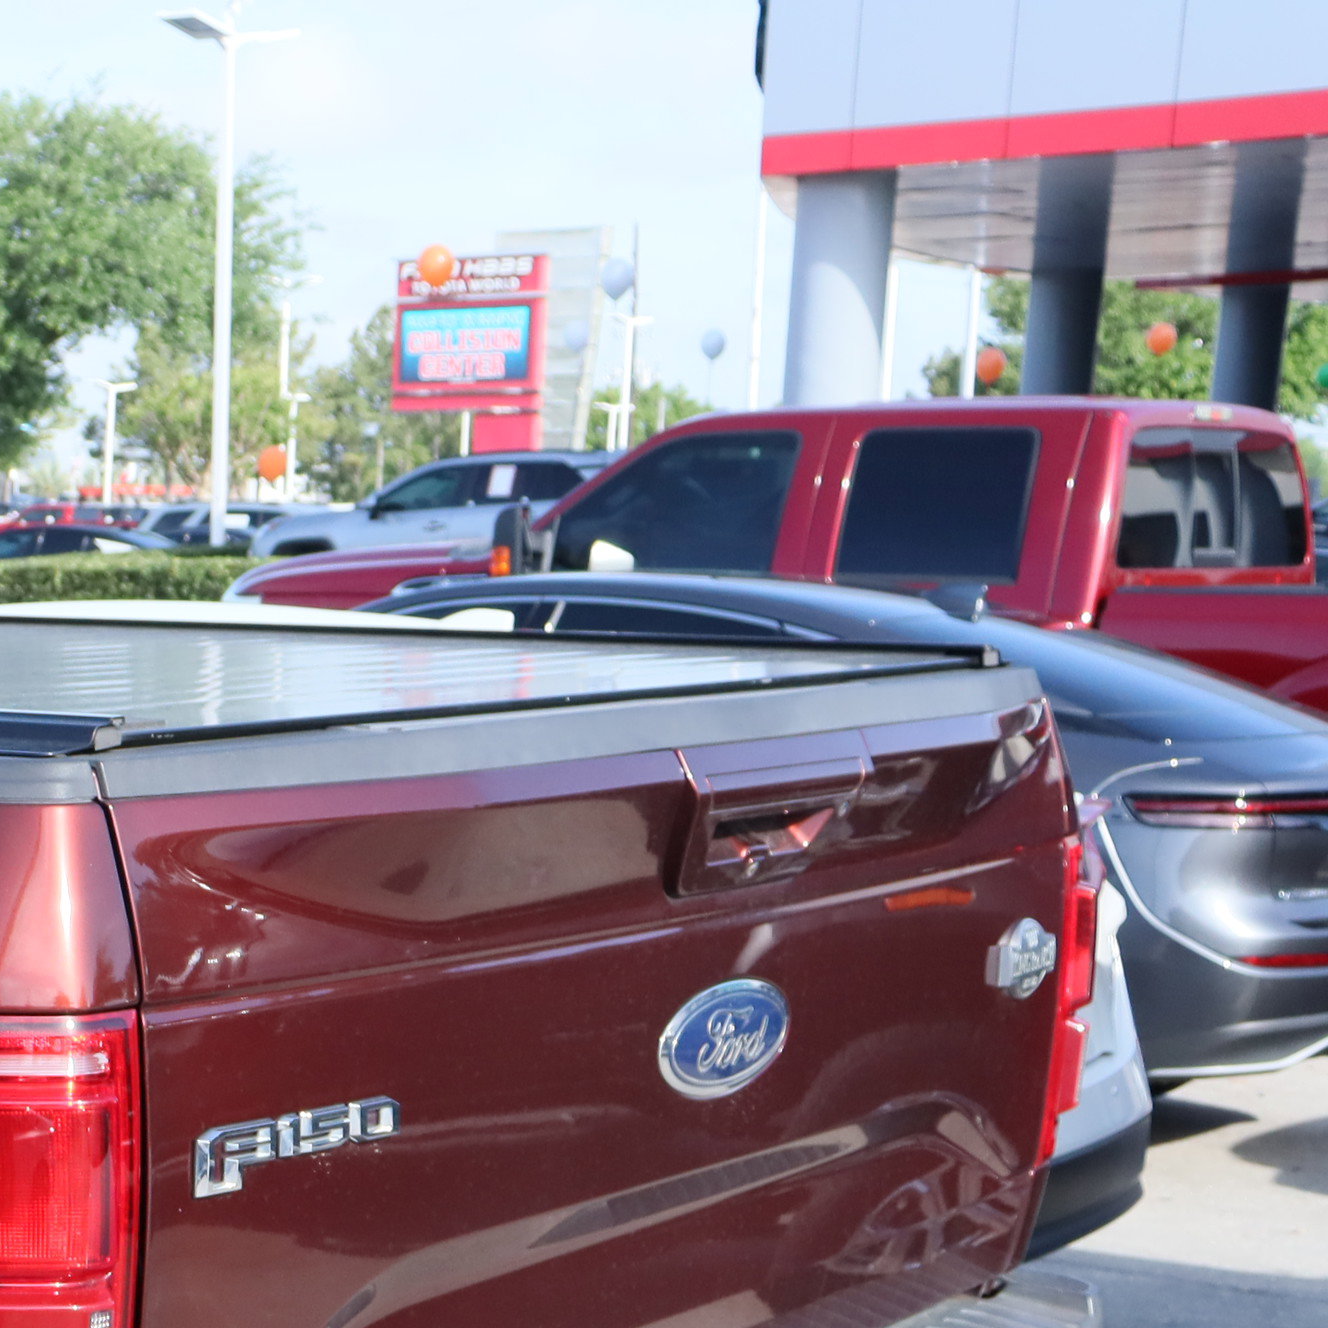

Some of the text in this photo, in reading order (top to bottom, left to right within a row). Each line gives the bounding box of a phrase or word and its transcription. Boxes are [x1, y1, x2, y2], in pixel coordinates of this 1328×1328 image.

[469, 275, 521, 293] WORLD
[407, 328, 523, 354] COLLISION
[418, 353, 506, 379] CENTER
[697, 1004, 770, 1073] Ford
